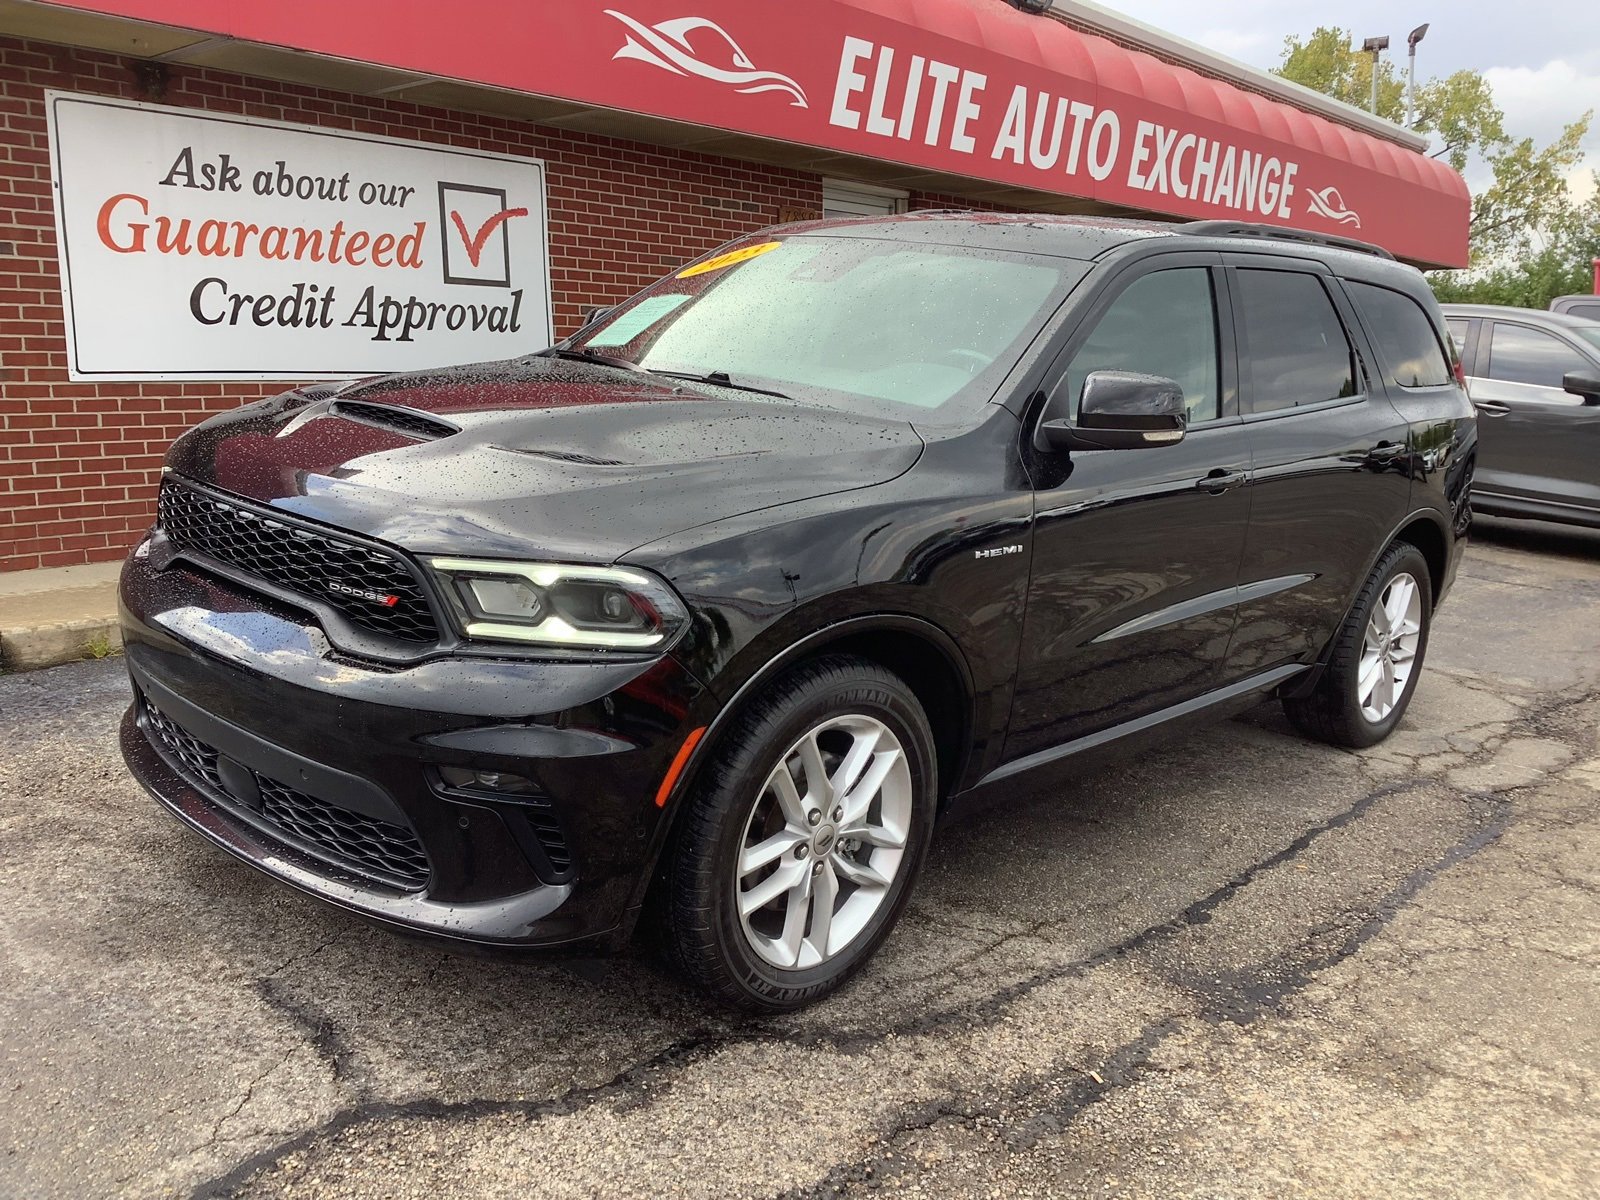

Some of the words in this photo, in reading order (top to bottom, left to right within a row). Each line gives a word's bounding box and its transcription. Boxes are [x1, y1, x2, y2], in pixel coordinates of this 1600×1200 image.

[829, 35, 988, 154] ELITE
[990, 84, 1121, 182] AUTO
[1126, 119, 1299, 220] EXCHANGE
[158, 146, 243, 193] Ask
[252, 160, 351, 203] about
[358, 181, 416, 208] our
[96, 193, 427, 269] Guaranteed
[189, 277, 336, 329] Credit
[340, 286, 524, 343] Approval
[975, 544, 1023, 559] HEMI
[329, 582, 389, 603] DODGE
